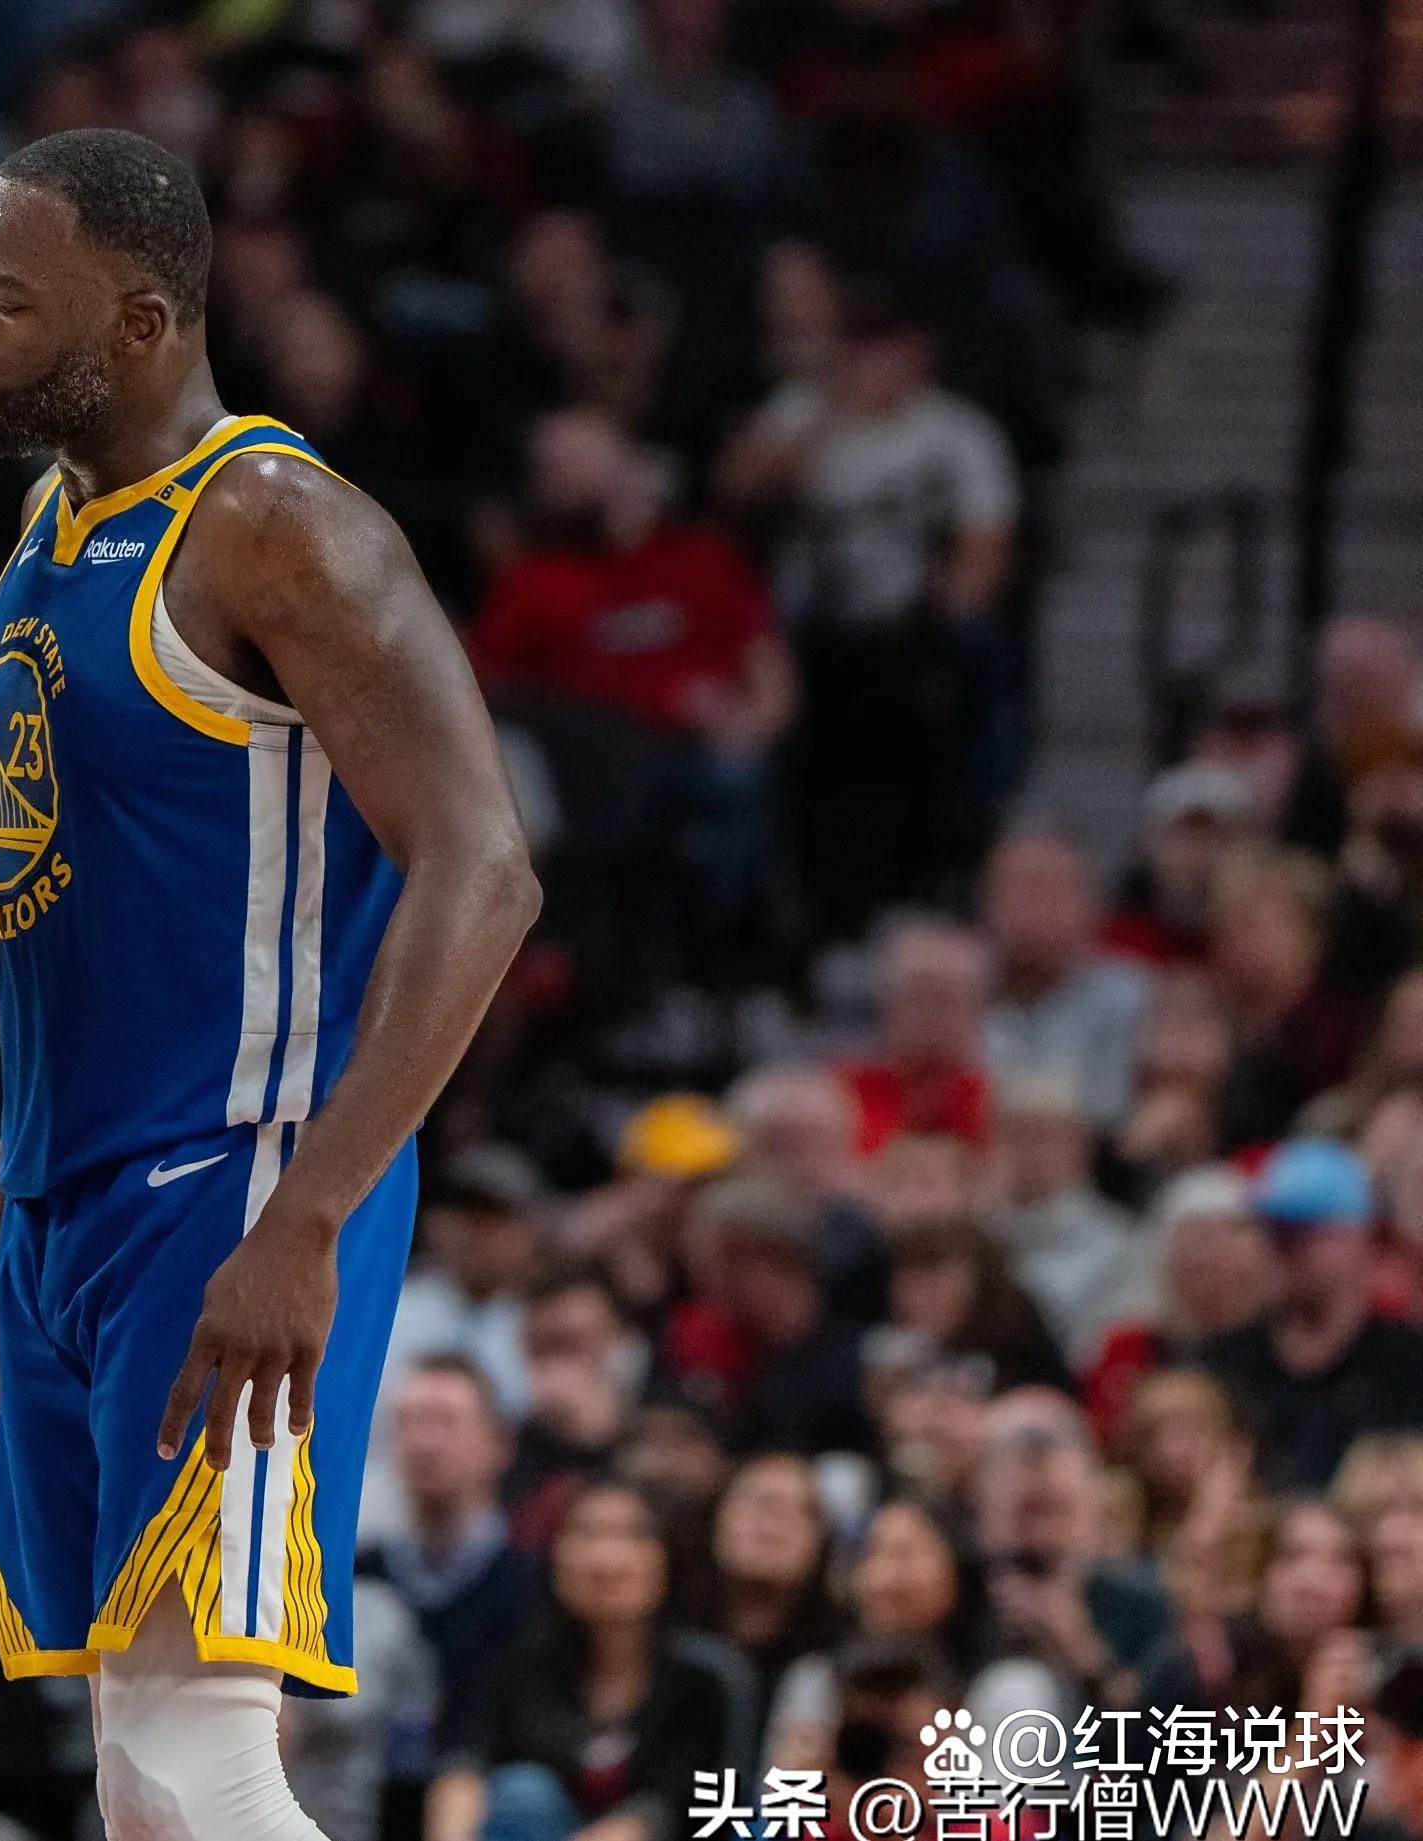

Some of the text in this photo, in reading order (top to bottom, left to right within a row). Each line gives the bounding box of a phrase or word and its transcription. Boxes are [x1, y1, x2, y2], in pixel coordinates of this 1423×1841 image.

[83, 536, 145, 559] Rakuten
[34, 623, 66, 700] STATE
[7, 711, 44, 781] 23
